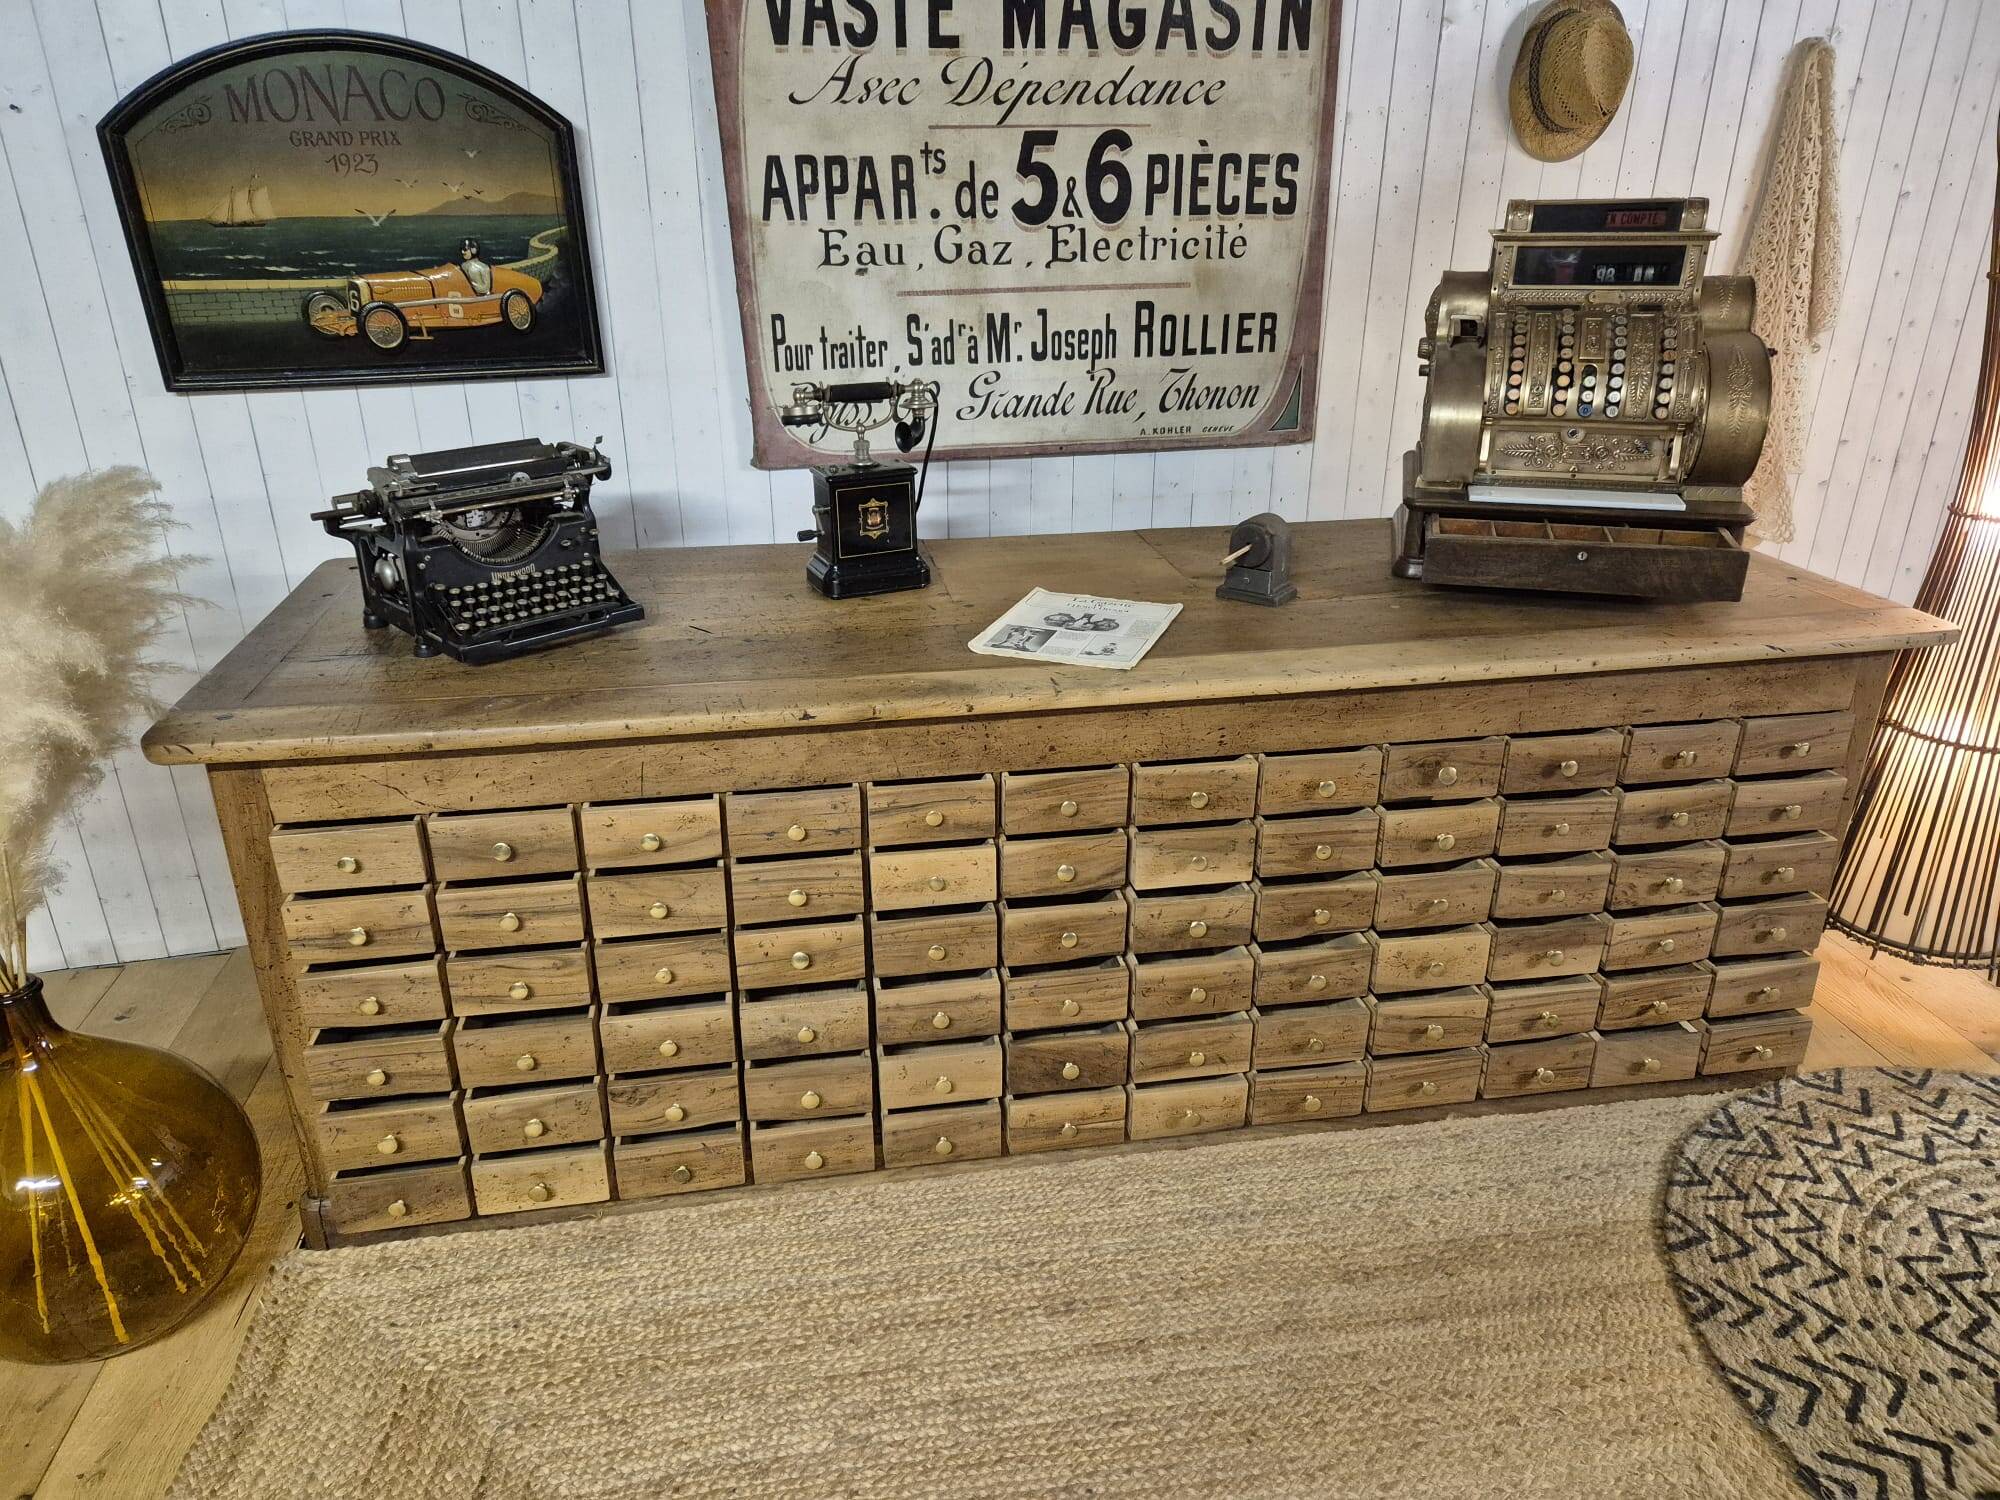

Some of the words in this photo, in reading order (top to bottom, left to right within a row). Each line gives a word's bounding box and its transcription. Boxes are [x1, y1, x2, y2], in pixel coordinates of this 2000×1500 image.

[764, 0, 960, 49] VASTE
[1003, 0, 1313, 51] MAGASIN
[224, 63, 446, 126] MONACO
[941, 55, 1227, 127] Dépendance
[289, 130, 354, 148] GRAND
[359, 130, 402, 146] PRIX
[324, 152, 379, 177] 1923
[955, 160, 999, 219] de
[1144, 139, 1300, 216] PIÈCES
[1620, 211, 1659, 225] COMPTE
[349, 290, 360, 311] 6
[771, 313, 814, 373] Pour
[1030, 308, 1117, 381] Joseph
[1134, 300, 1278, 358] ROLLIER
[1158, 364, 1261, 413] Thonon
[1152, 425, 1192, 436] KOHLER
[490, 562, 536, 581] UNDERWOOD
